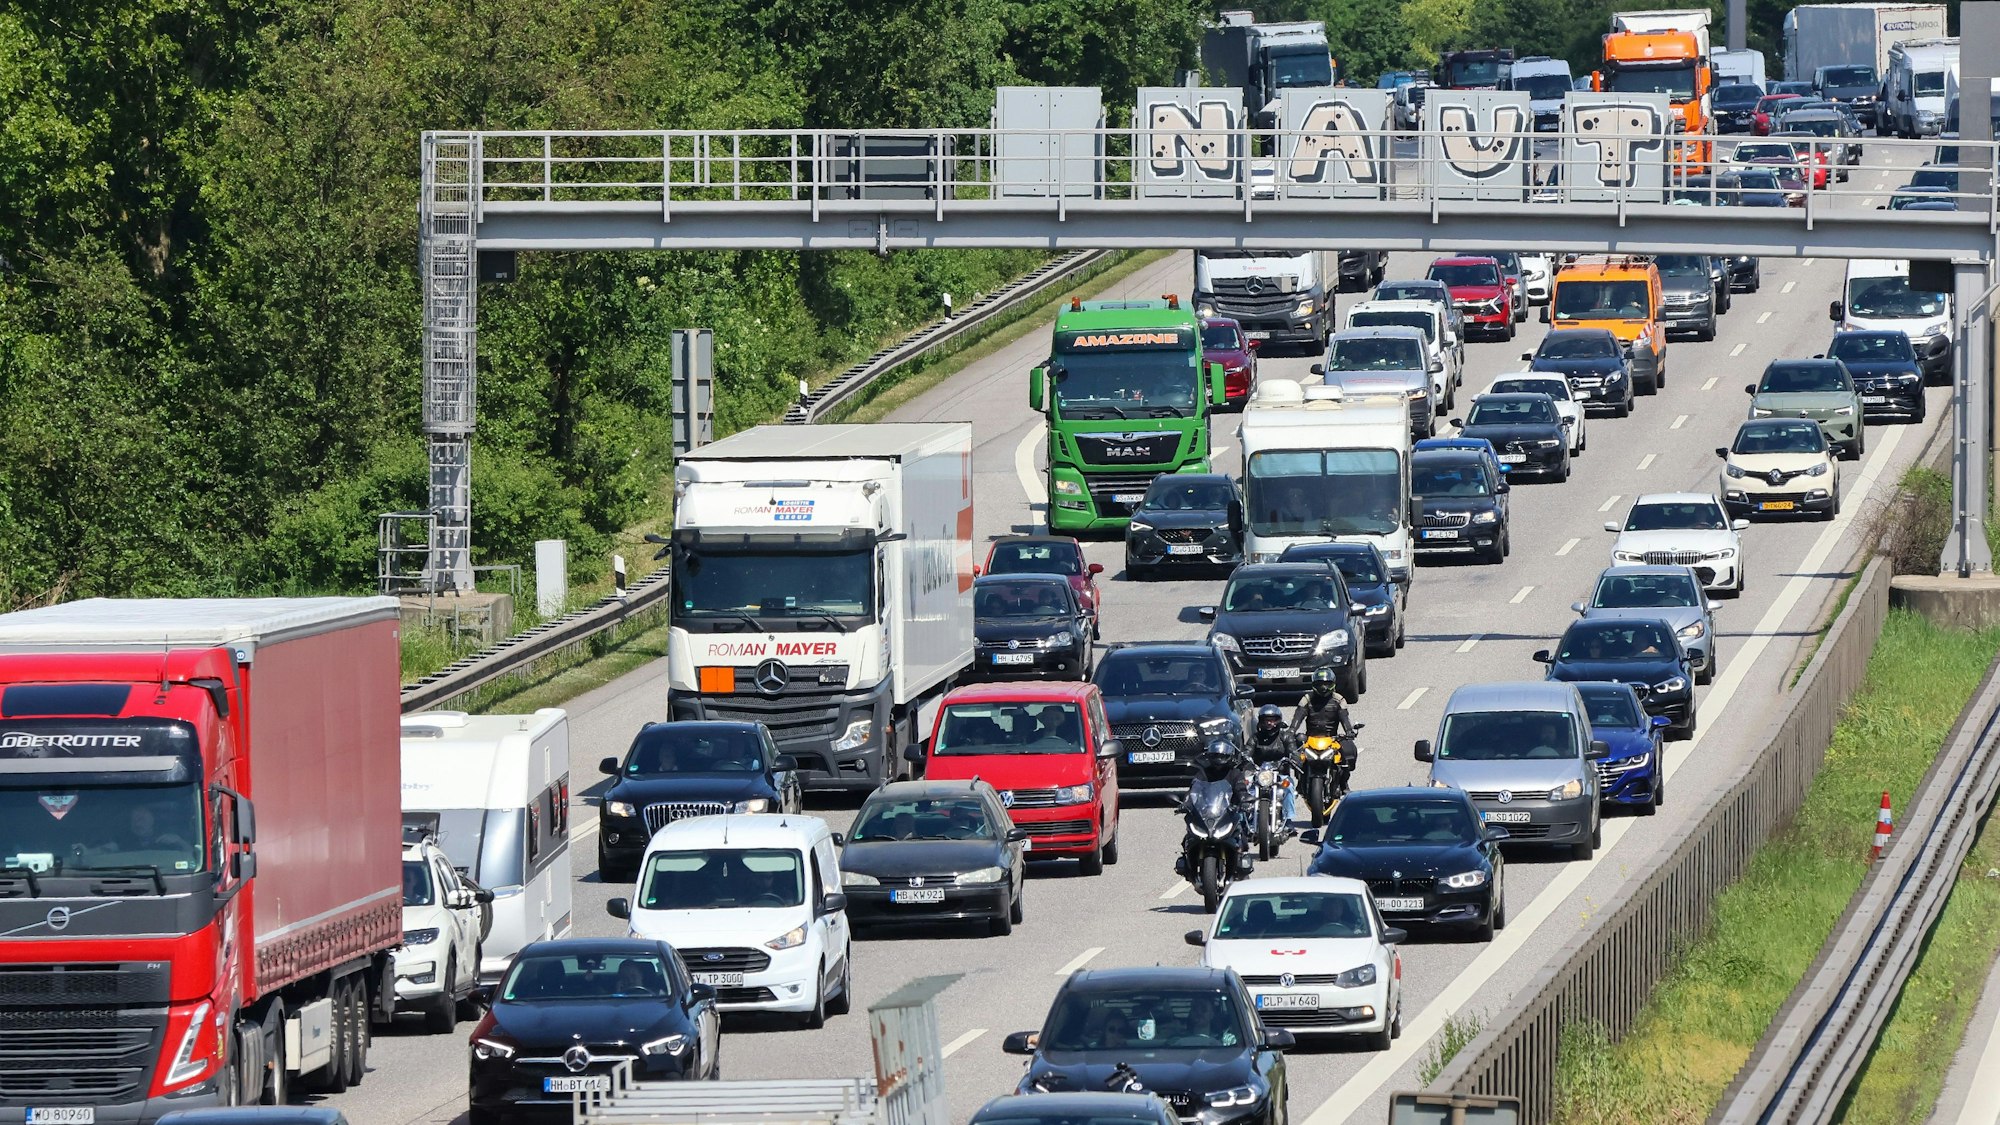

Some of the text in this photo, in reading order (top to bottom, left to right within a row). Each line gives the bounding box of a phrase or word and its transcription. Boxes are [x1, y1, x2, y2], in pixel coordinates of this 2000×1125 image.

[1073, 333, 1179, 347] AMAZONE
[1106, 446, 1151, 457] MAN
[734, 506, 814, 515] ROMAN MAYER
[708, 642, 837, 656] ROMAN MAYER
[0, 733, 142, 750] OBETROTTER
[1508, 813, 1530, 822] 1022
[896, 888, 943, 900] HB KW 921
[1404, 899, 1423, 908] 1213
[708, 974, 719, 983] TP
[721, 974, 742, 983] 3000
[1263, 996, 1317, 1007] CLP W 648
[550, 1081, 563, 1091] HH
[570, 1080, 582, 1090] BT
[34, 1108, 91, 1121] WO 80960
